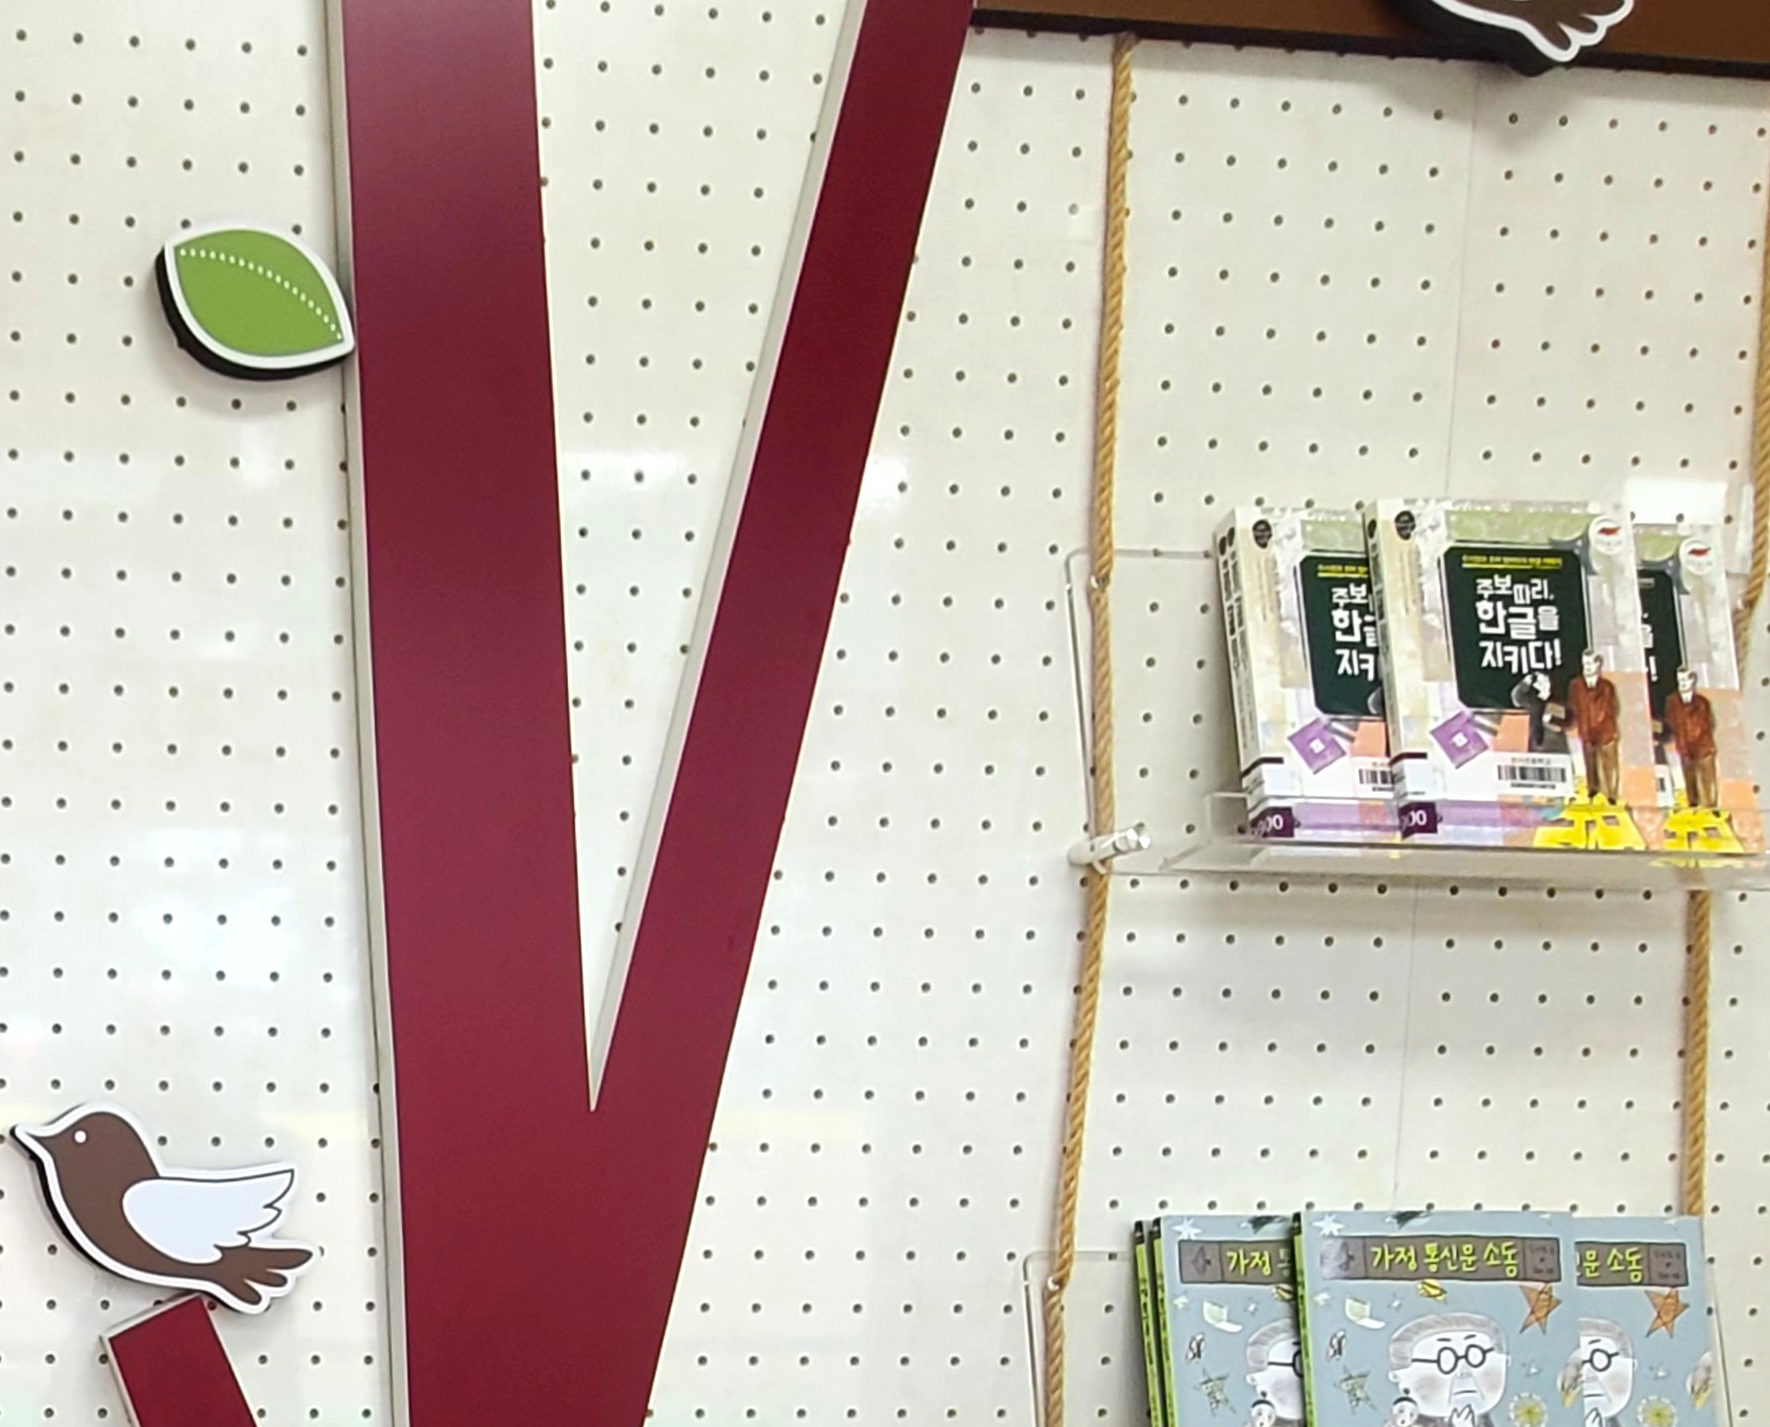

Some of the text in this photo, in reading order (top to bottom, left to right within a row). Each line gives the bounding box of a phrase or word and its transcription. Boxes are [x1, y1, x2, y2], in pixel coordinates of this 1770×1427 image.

[1475, 574, 1555, 605] 주보따리,
[1475, 600, 1560, 640] 한글을
[1478, 638, 1562, 675] 지키다!
[1227, 1248, 1272, 1277] 가정
[1371, 1244, 1418, 1273] 가정
[1423, 1244, 1477, 1274] 통신문
[1483, 1242, 1520, 1278] 소동
[1607, 1247, 1644, 1284] 소동
